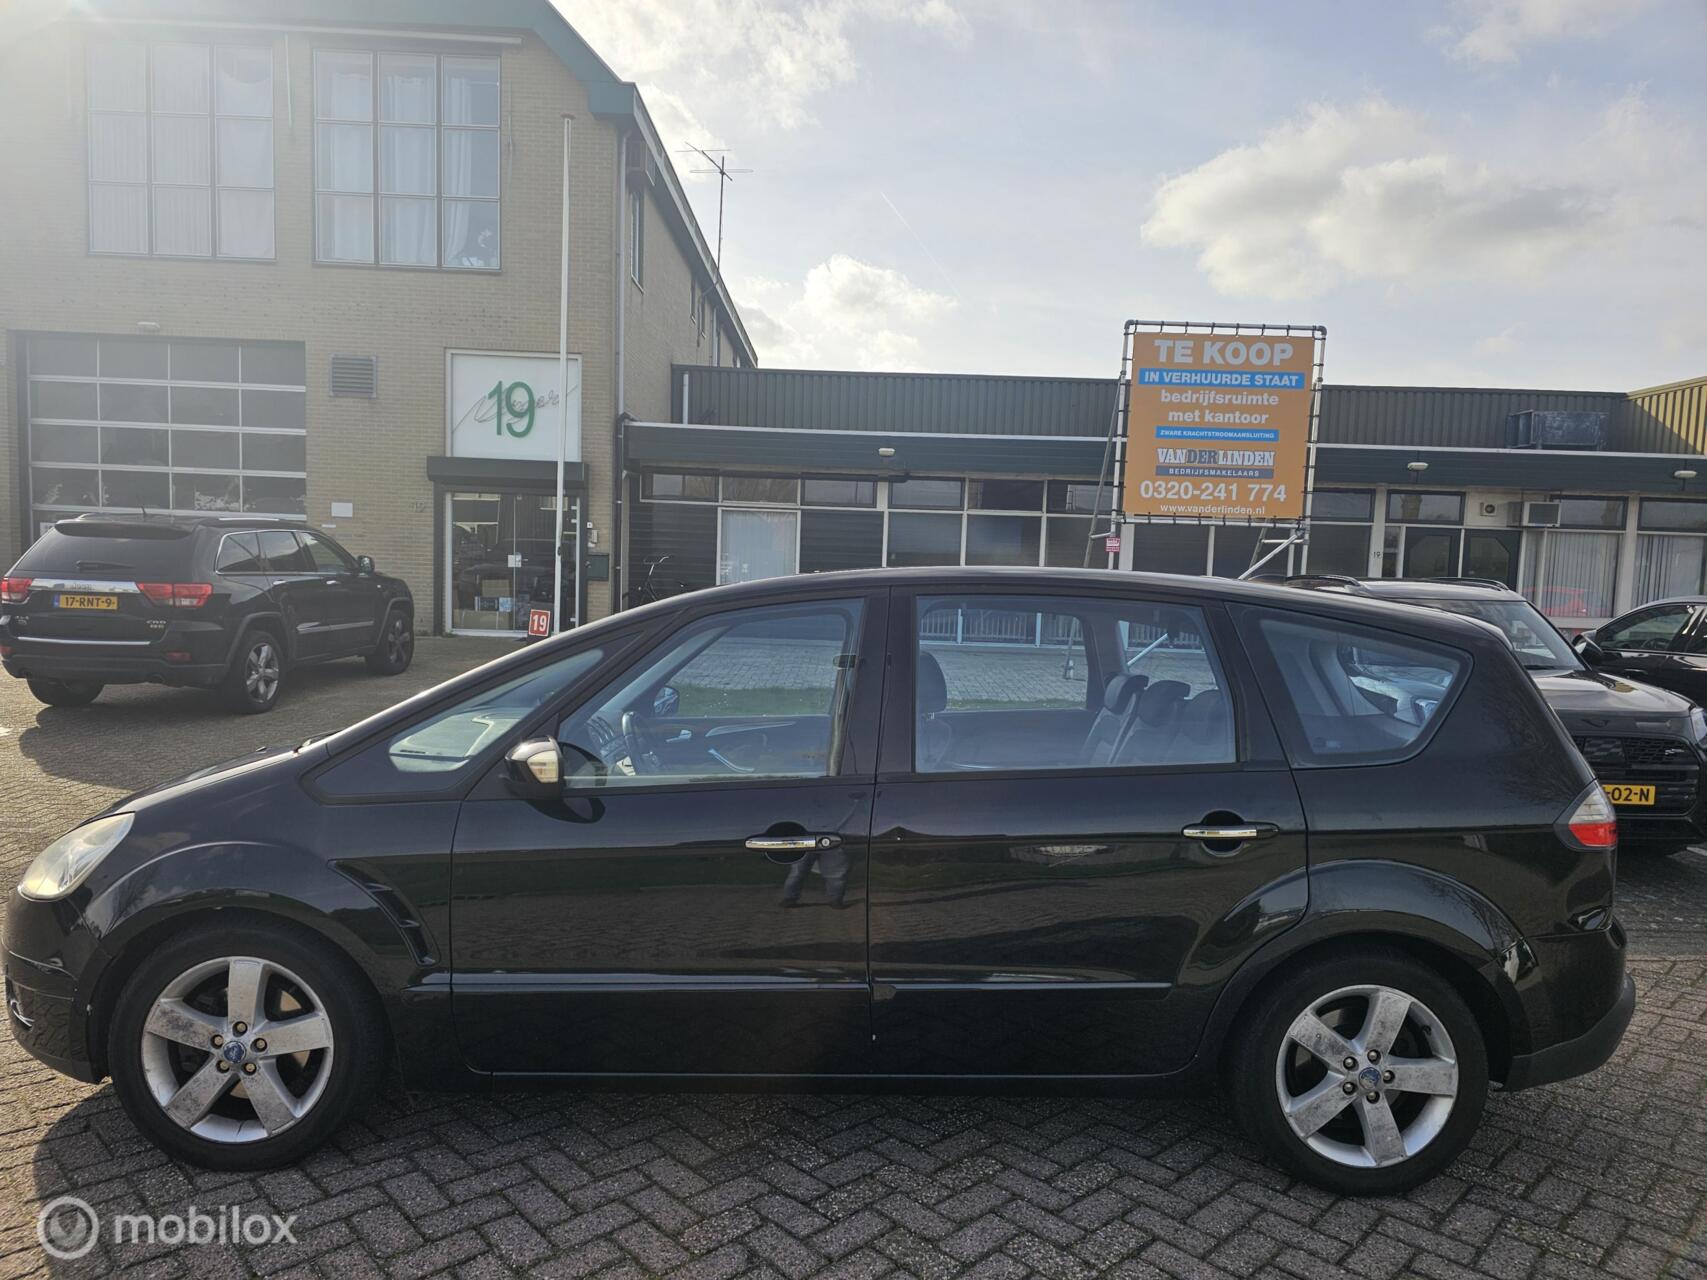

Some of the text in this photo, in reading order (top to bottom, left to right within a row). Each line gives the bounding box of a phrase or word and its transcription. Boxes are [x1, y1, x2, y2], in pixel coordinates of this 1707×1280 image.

[1153, 339, 1294, 367] TE KOOP
[1144, 371, 1299, 387] IN VERHUURDE STAAT
[1160, 389, 1280, 406] bedrijfsruimte
[487, 380, 535, 438] 19
[1168, 410, 1269, 424] met kantoor
[1156, 448, 1275, 466] VANDERLINDEN
[1168, 468, 1260, 477] BEDRIJFSMAKELAARS
[1139, 480, 1287, 502] 0320-241 774
[1160, 504, 1265, 515] www.vanderlinden.nl
[64, 596, 113, 608] 17-RNT-9
[532, 614, 548, 632] 19
